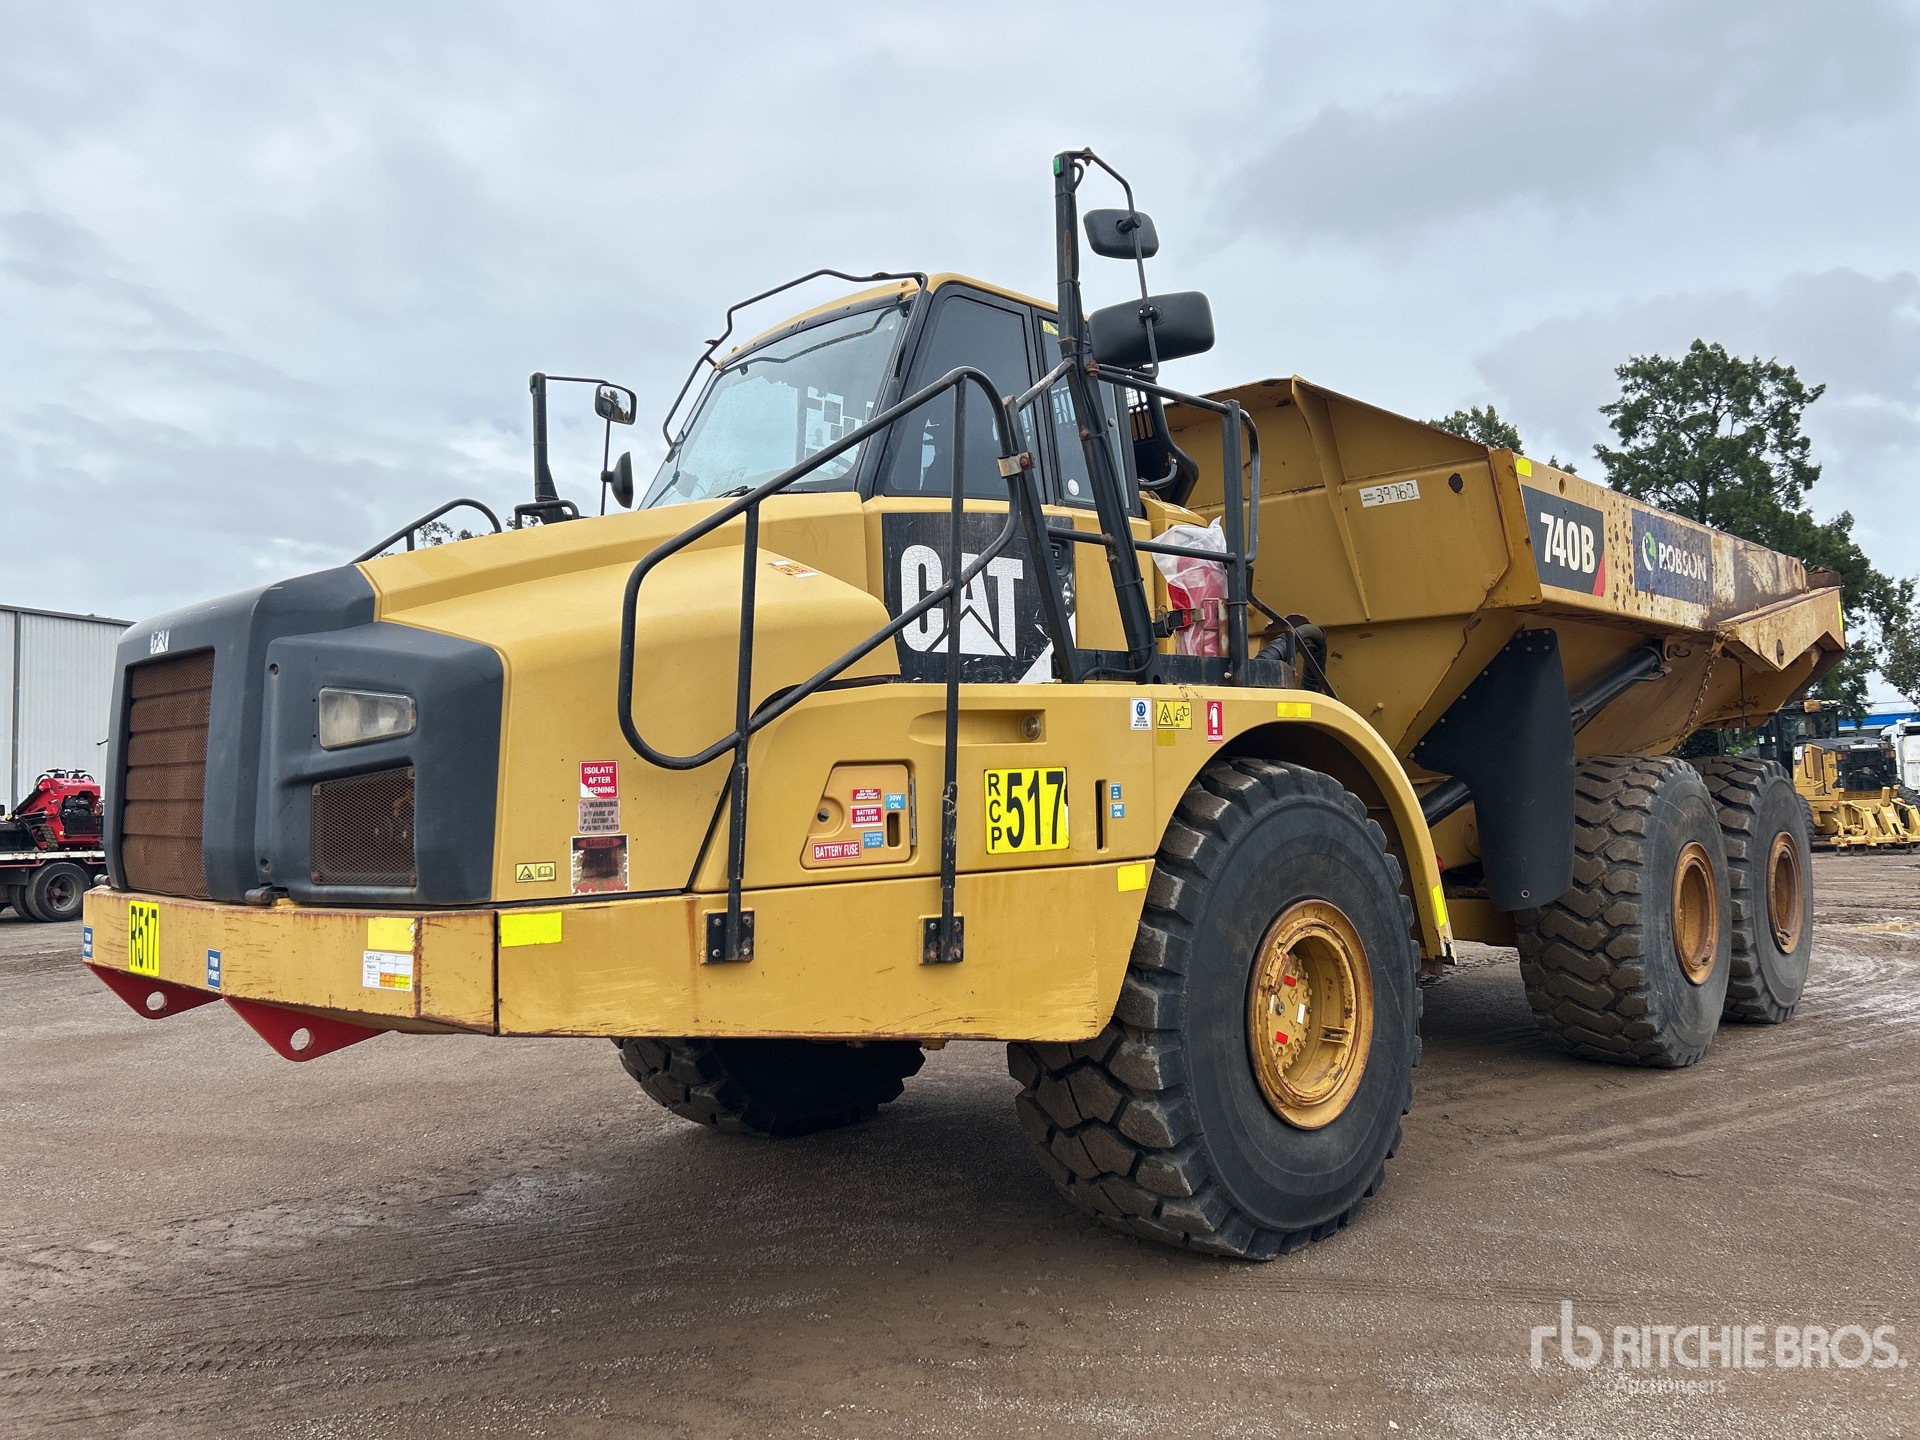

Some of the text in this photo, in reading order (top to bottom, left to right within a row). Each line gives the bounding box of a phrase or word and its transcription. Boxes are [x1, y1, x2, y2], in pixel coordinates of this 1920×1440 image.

[1541, 512, 1595, 574] 740B
[1659, 542, 1706, 581] ROBSON
[901, 544, 1023, 659] CAT
[584, 766, 614, 774] ISOLATE
[588, 776, 611, 784] AFTER
[586, 786, 615, 794] PENING
[1006, 770, 1064, 848] 517
[586, 839, 614, 847] DANGER
[815, 843, 859, 859] BATTERY FUSE
[130, 905, 157, 970] R517
[209, 956, 219, 968] TOW
[208, 969, 220, 981] POINT
